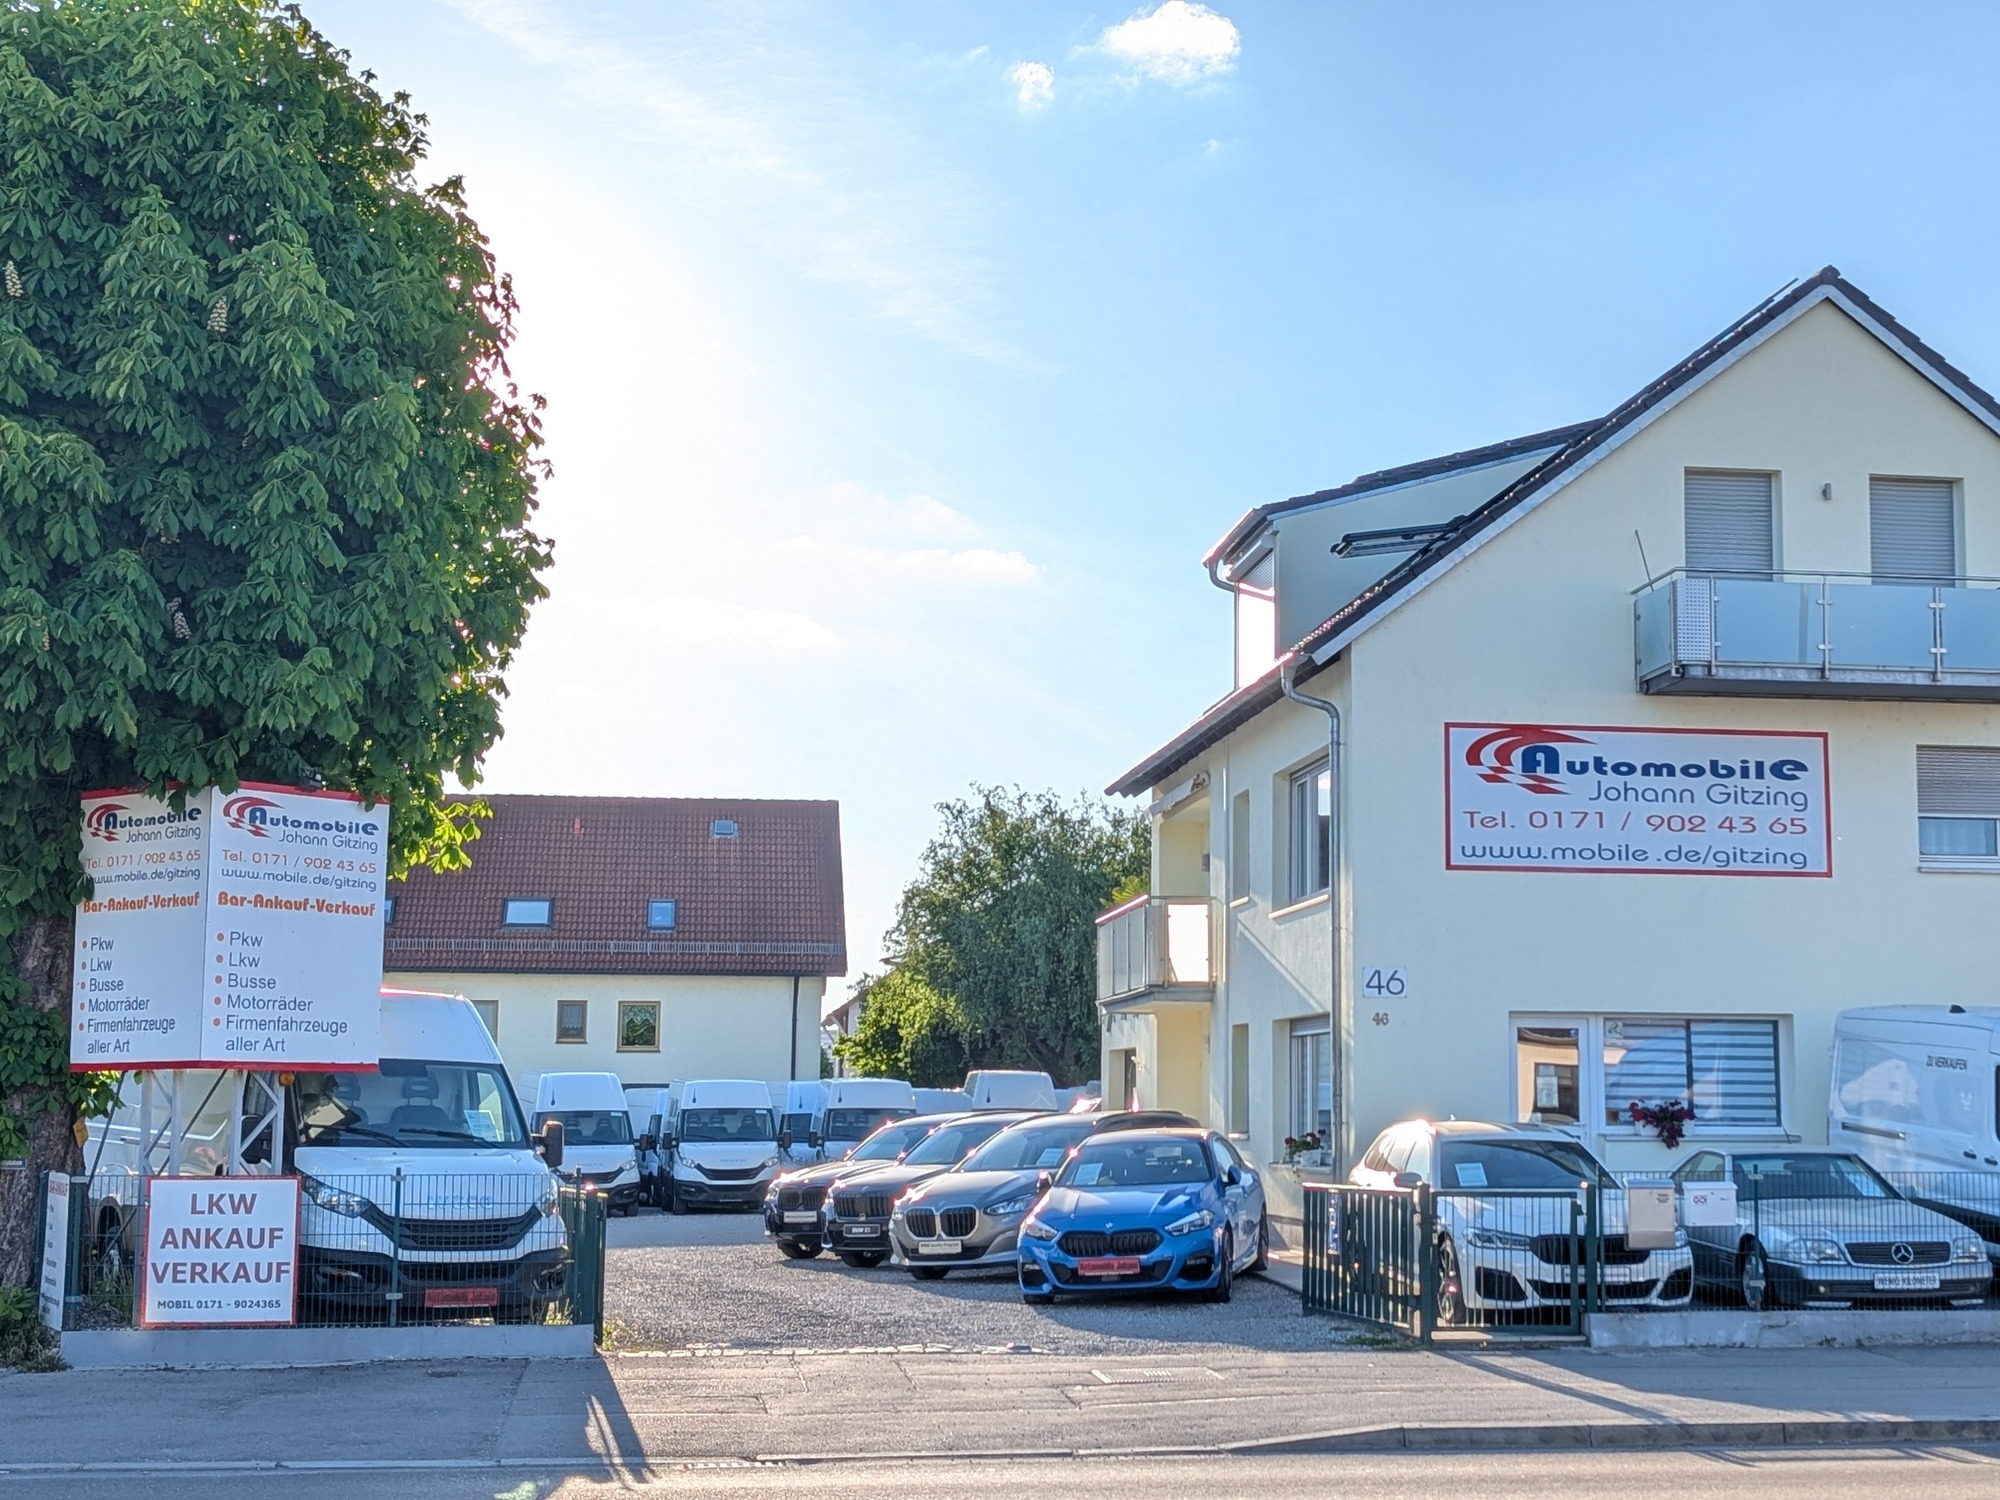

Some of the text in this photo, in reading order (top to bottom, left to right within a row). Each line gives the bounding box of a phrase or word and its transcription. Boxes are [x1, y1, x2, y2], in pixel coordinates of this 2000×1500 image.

[1521, 744, 1809, 781] Automobile
[1588, 780, 1808, 812] Johann Gitzing
[104, 807, 202, 831] Automobile
[249, 807, 379, 836] Automobile
[1463, 811, 1807, 835] Tel. 0171 / 902 43 65
[125, 825, 201, 844] Johann Gitzing
[279, 830, 378, 854] Johann Gitzing
[86, 850, 200, 869] Tel. 0171 / 902 43 65
[222, 849, 377, 873] Tel. 0171 / 902 43 65
[94, 867, 201, 884] ww.mobile.de/gitzing
[221, 868, 377, 892] www.mobile.de/gitzing
[83, 891, 200, 913] Bar-Ankauf-Verkauf
[217, 891, 375, 917] Bar-Ankauf-Verkauf
[90, 936, 114, 951] Pkw
[229, 931, 263, 947] Pkw
[90, 957, 113, 972] Lkw
[229, 952, 261, 968] Lkw
[89, 978, 124, 992] Busse
[228, 973, 277, 989] Busse
[1366, 970, 1405, 995] 46
[88, 996, 150, 1013] Motorräder
[227, 994, 313, 1011] Motorräder
[87, 1017, 176, 1034] Firmenfahrzeuge
[226, 1014, 348, 1037] Firmenfahrzeuge
[1372, 1012, 1389, 1026] 46
[87, 1038, 131, 1054] aller Art
[225, 1036, 286, 1052] aller Art
[190, 1193, 257, 1215] LKW
[159, 1227, 284, 1250] ANKAUF
[150, 1262, 291, 1284] VERKAUF
[157, 1300, 193, 1309] MOBIL
[196, 1300, 223, 1309] 0171
[234, 1299, 281, 1309] 9024365
